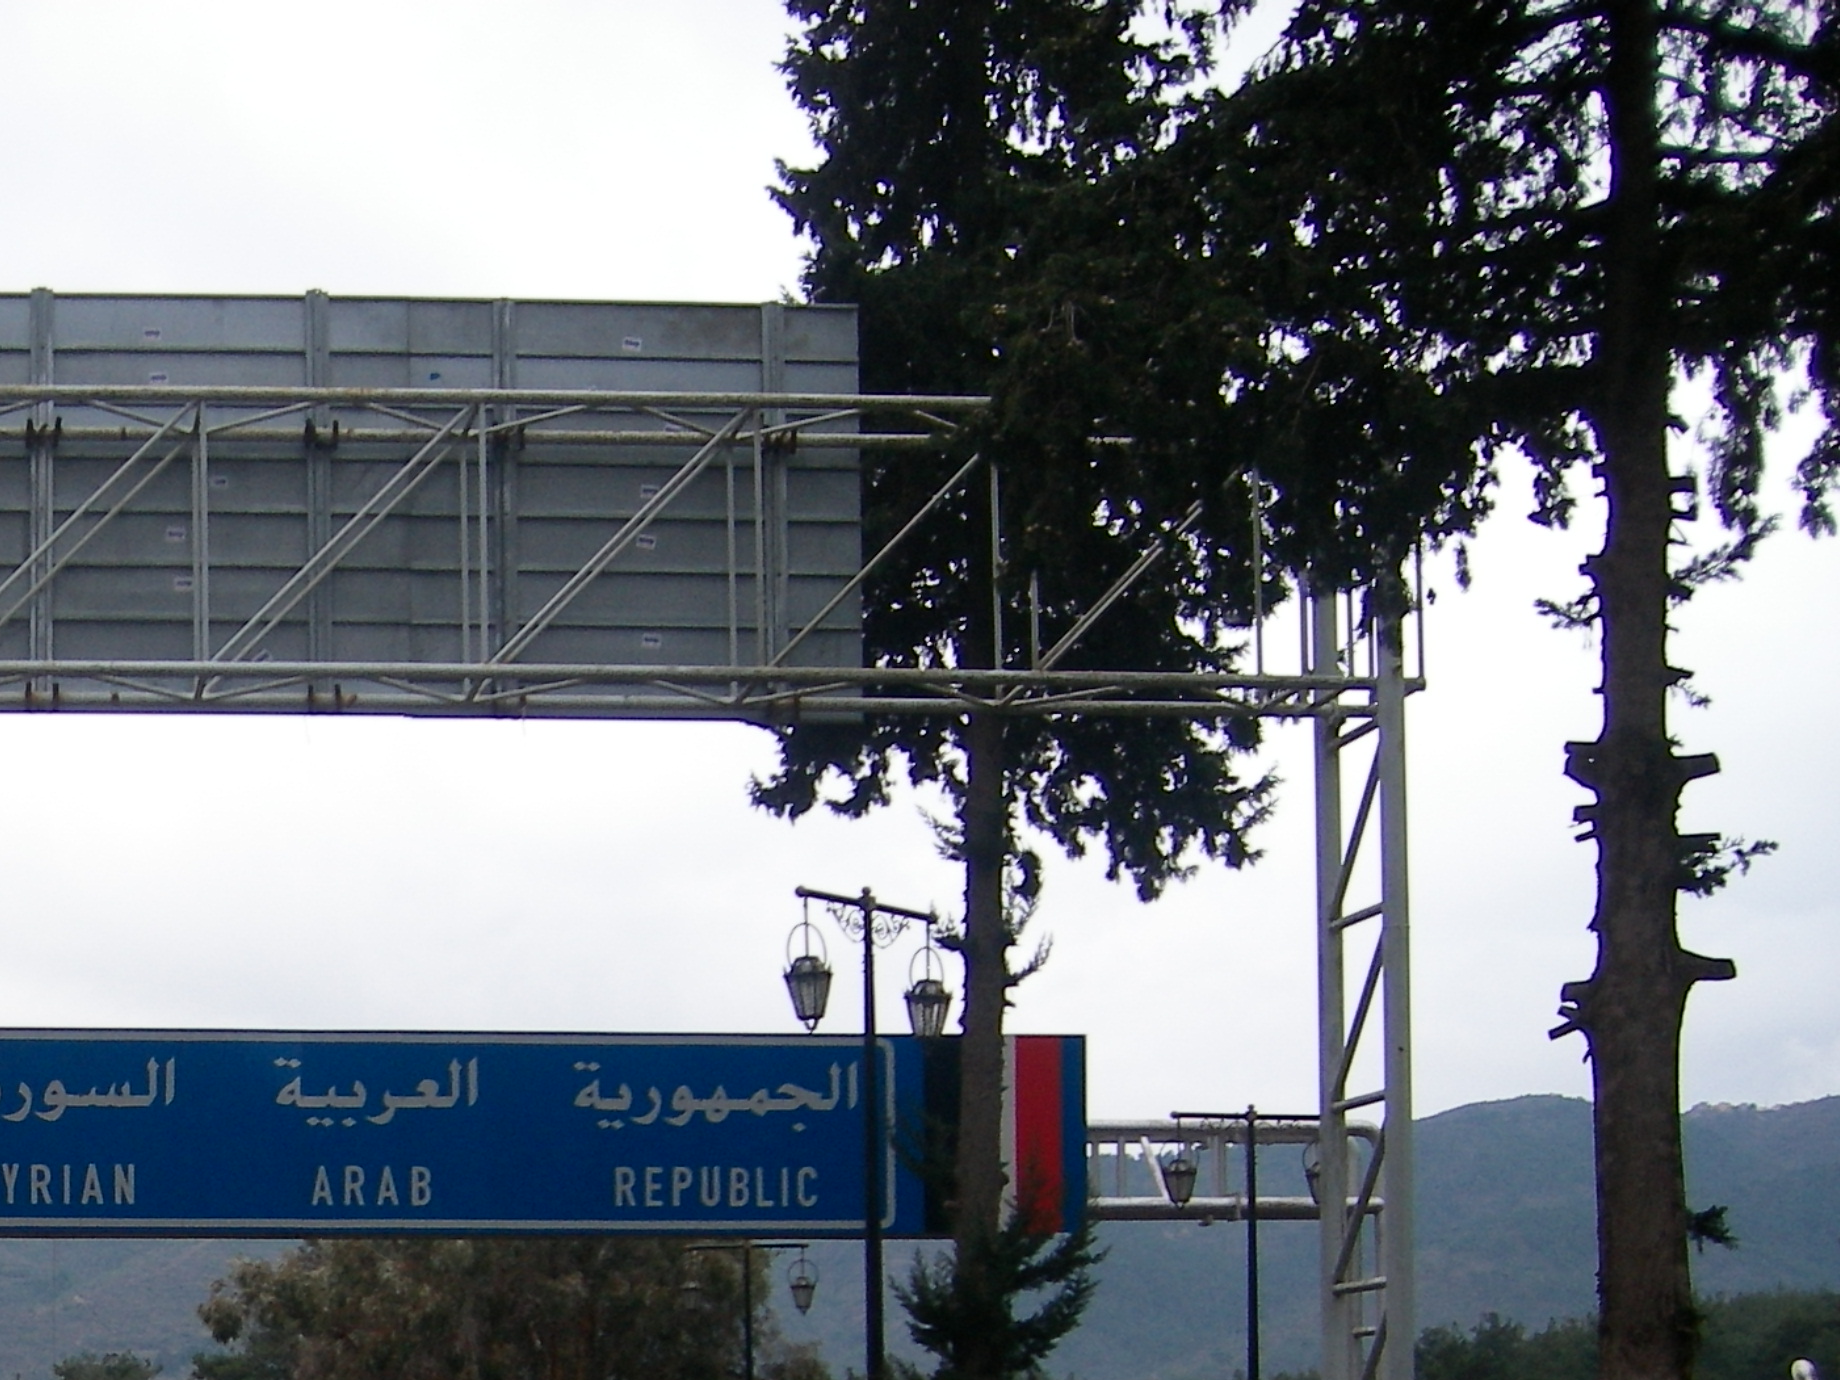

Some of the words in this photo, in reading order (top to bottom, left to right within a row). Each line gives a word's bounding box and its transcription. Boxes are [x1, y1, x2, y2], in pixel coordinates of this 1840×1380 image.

[274, 1057, 477, 1126] العربية
[574, 1061, 858, 1131] الجمهورية
[312, 1165, 431, 1206] ARAB
[615, 1166, 818, 1207] REPUBLIC
